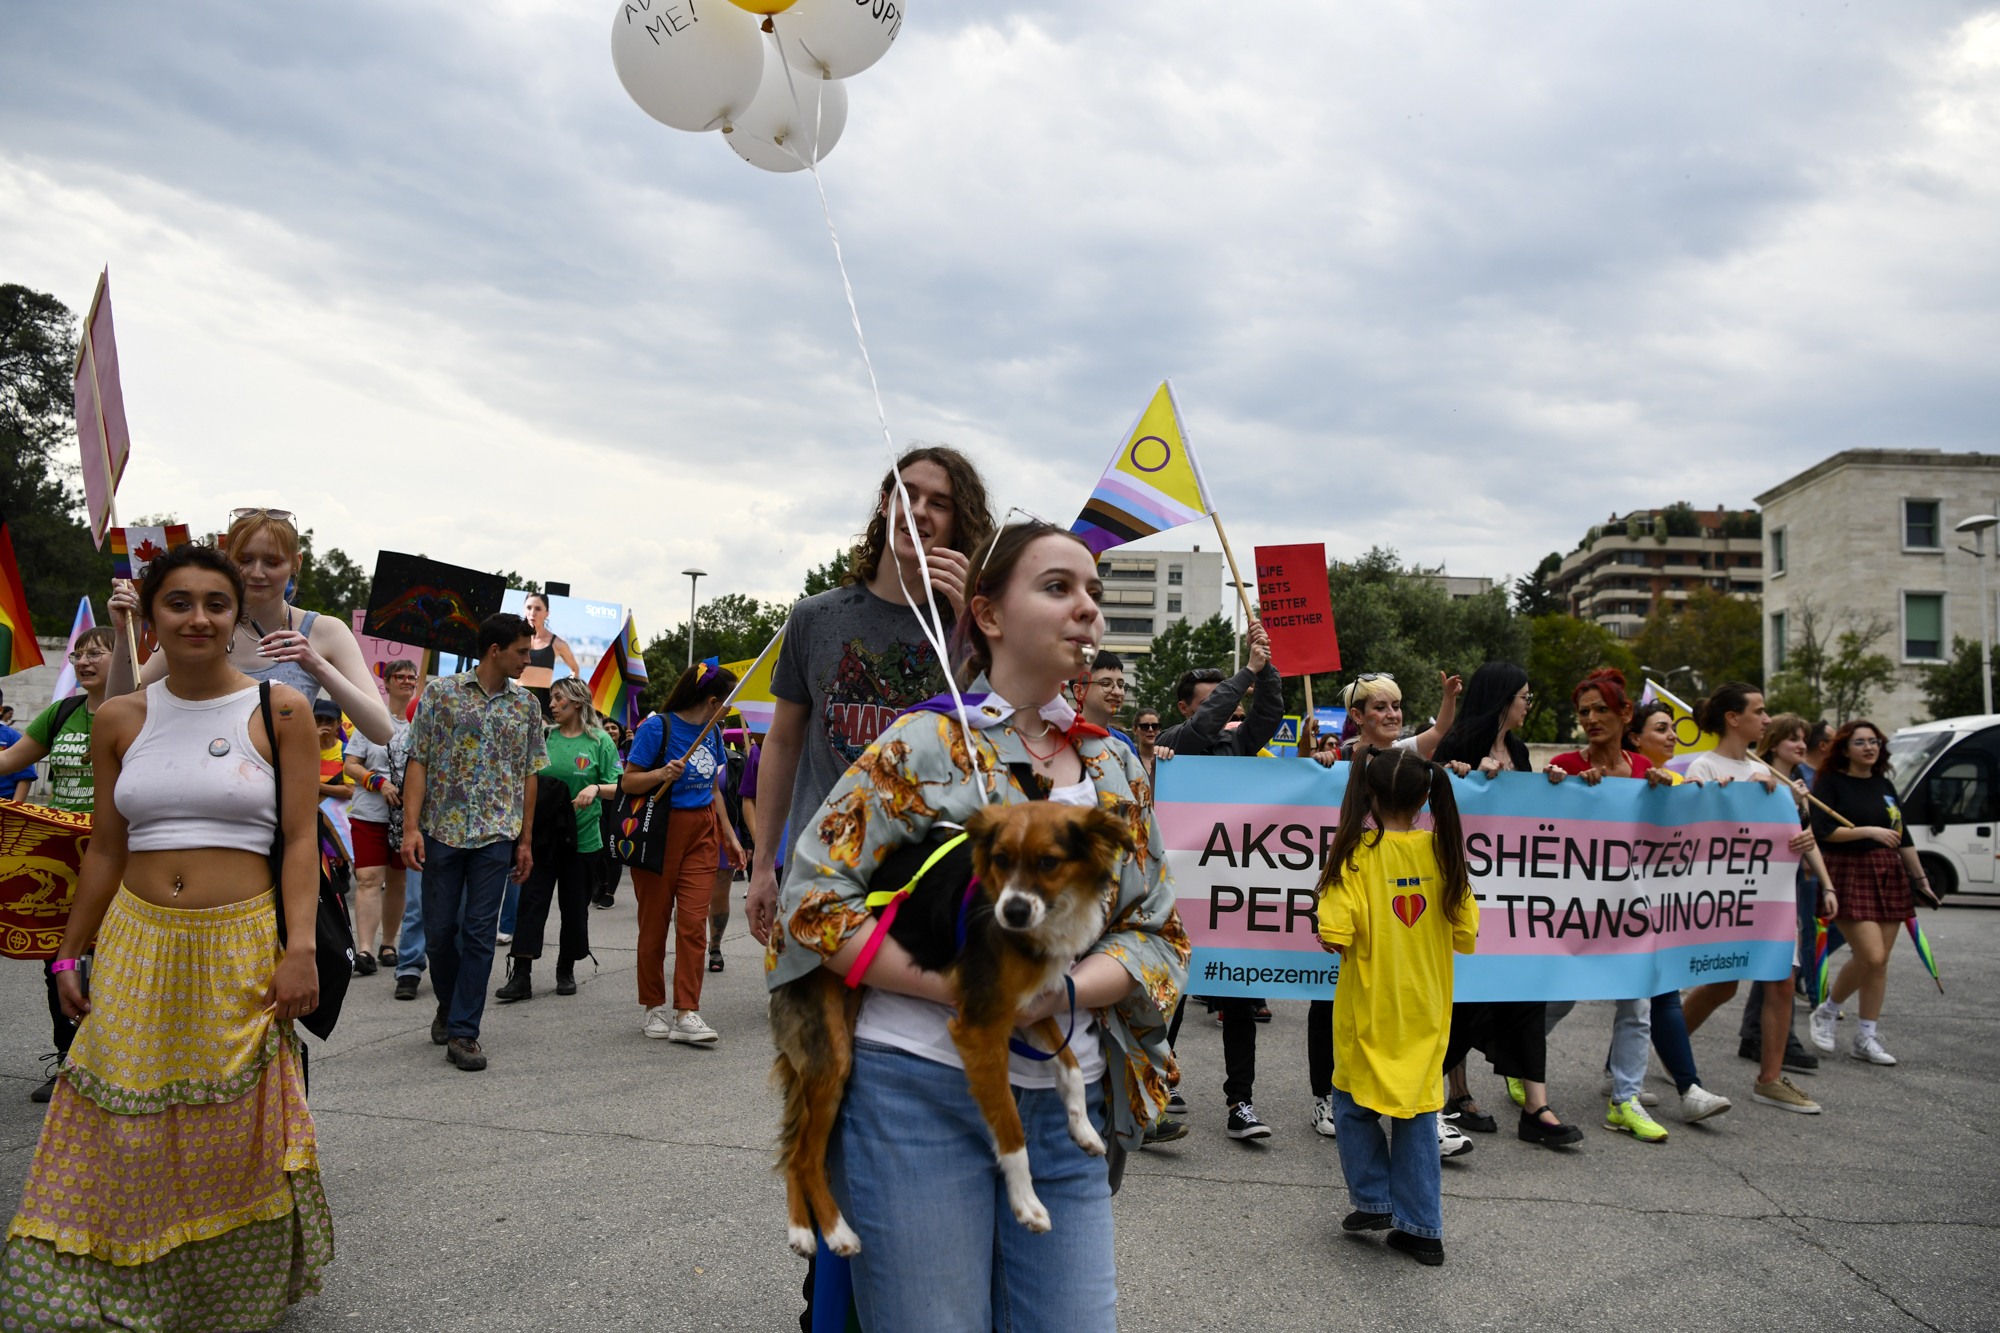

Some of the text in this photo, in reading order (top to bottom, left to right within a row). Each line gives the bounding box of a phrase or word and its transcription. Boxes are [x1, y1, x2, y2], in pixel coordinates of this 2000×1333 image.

[645, 0, 698, 45] ME!
[855, 0, 902, 41] OPTO
[1258, 565, 1283, 578] LIFE
[1260, 582, 1291, 595] GETS
[1262, 597, 1307, 611] BETTER
[1264, 613, 1323, 629] TOGETHER
[370, 638, 404, 656] TO
[63, 733, 90, 741] GAY
[1465, 824, 1700, 881] SHËNDETËSI
[1707, 827, 1773, 875] PËR
[1209, 885, 1320, 934] PER
[1689, 951, 1749, 976] #përdashni
